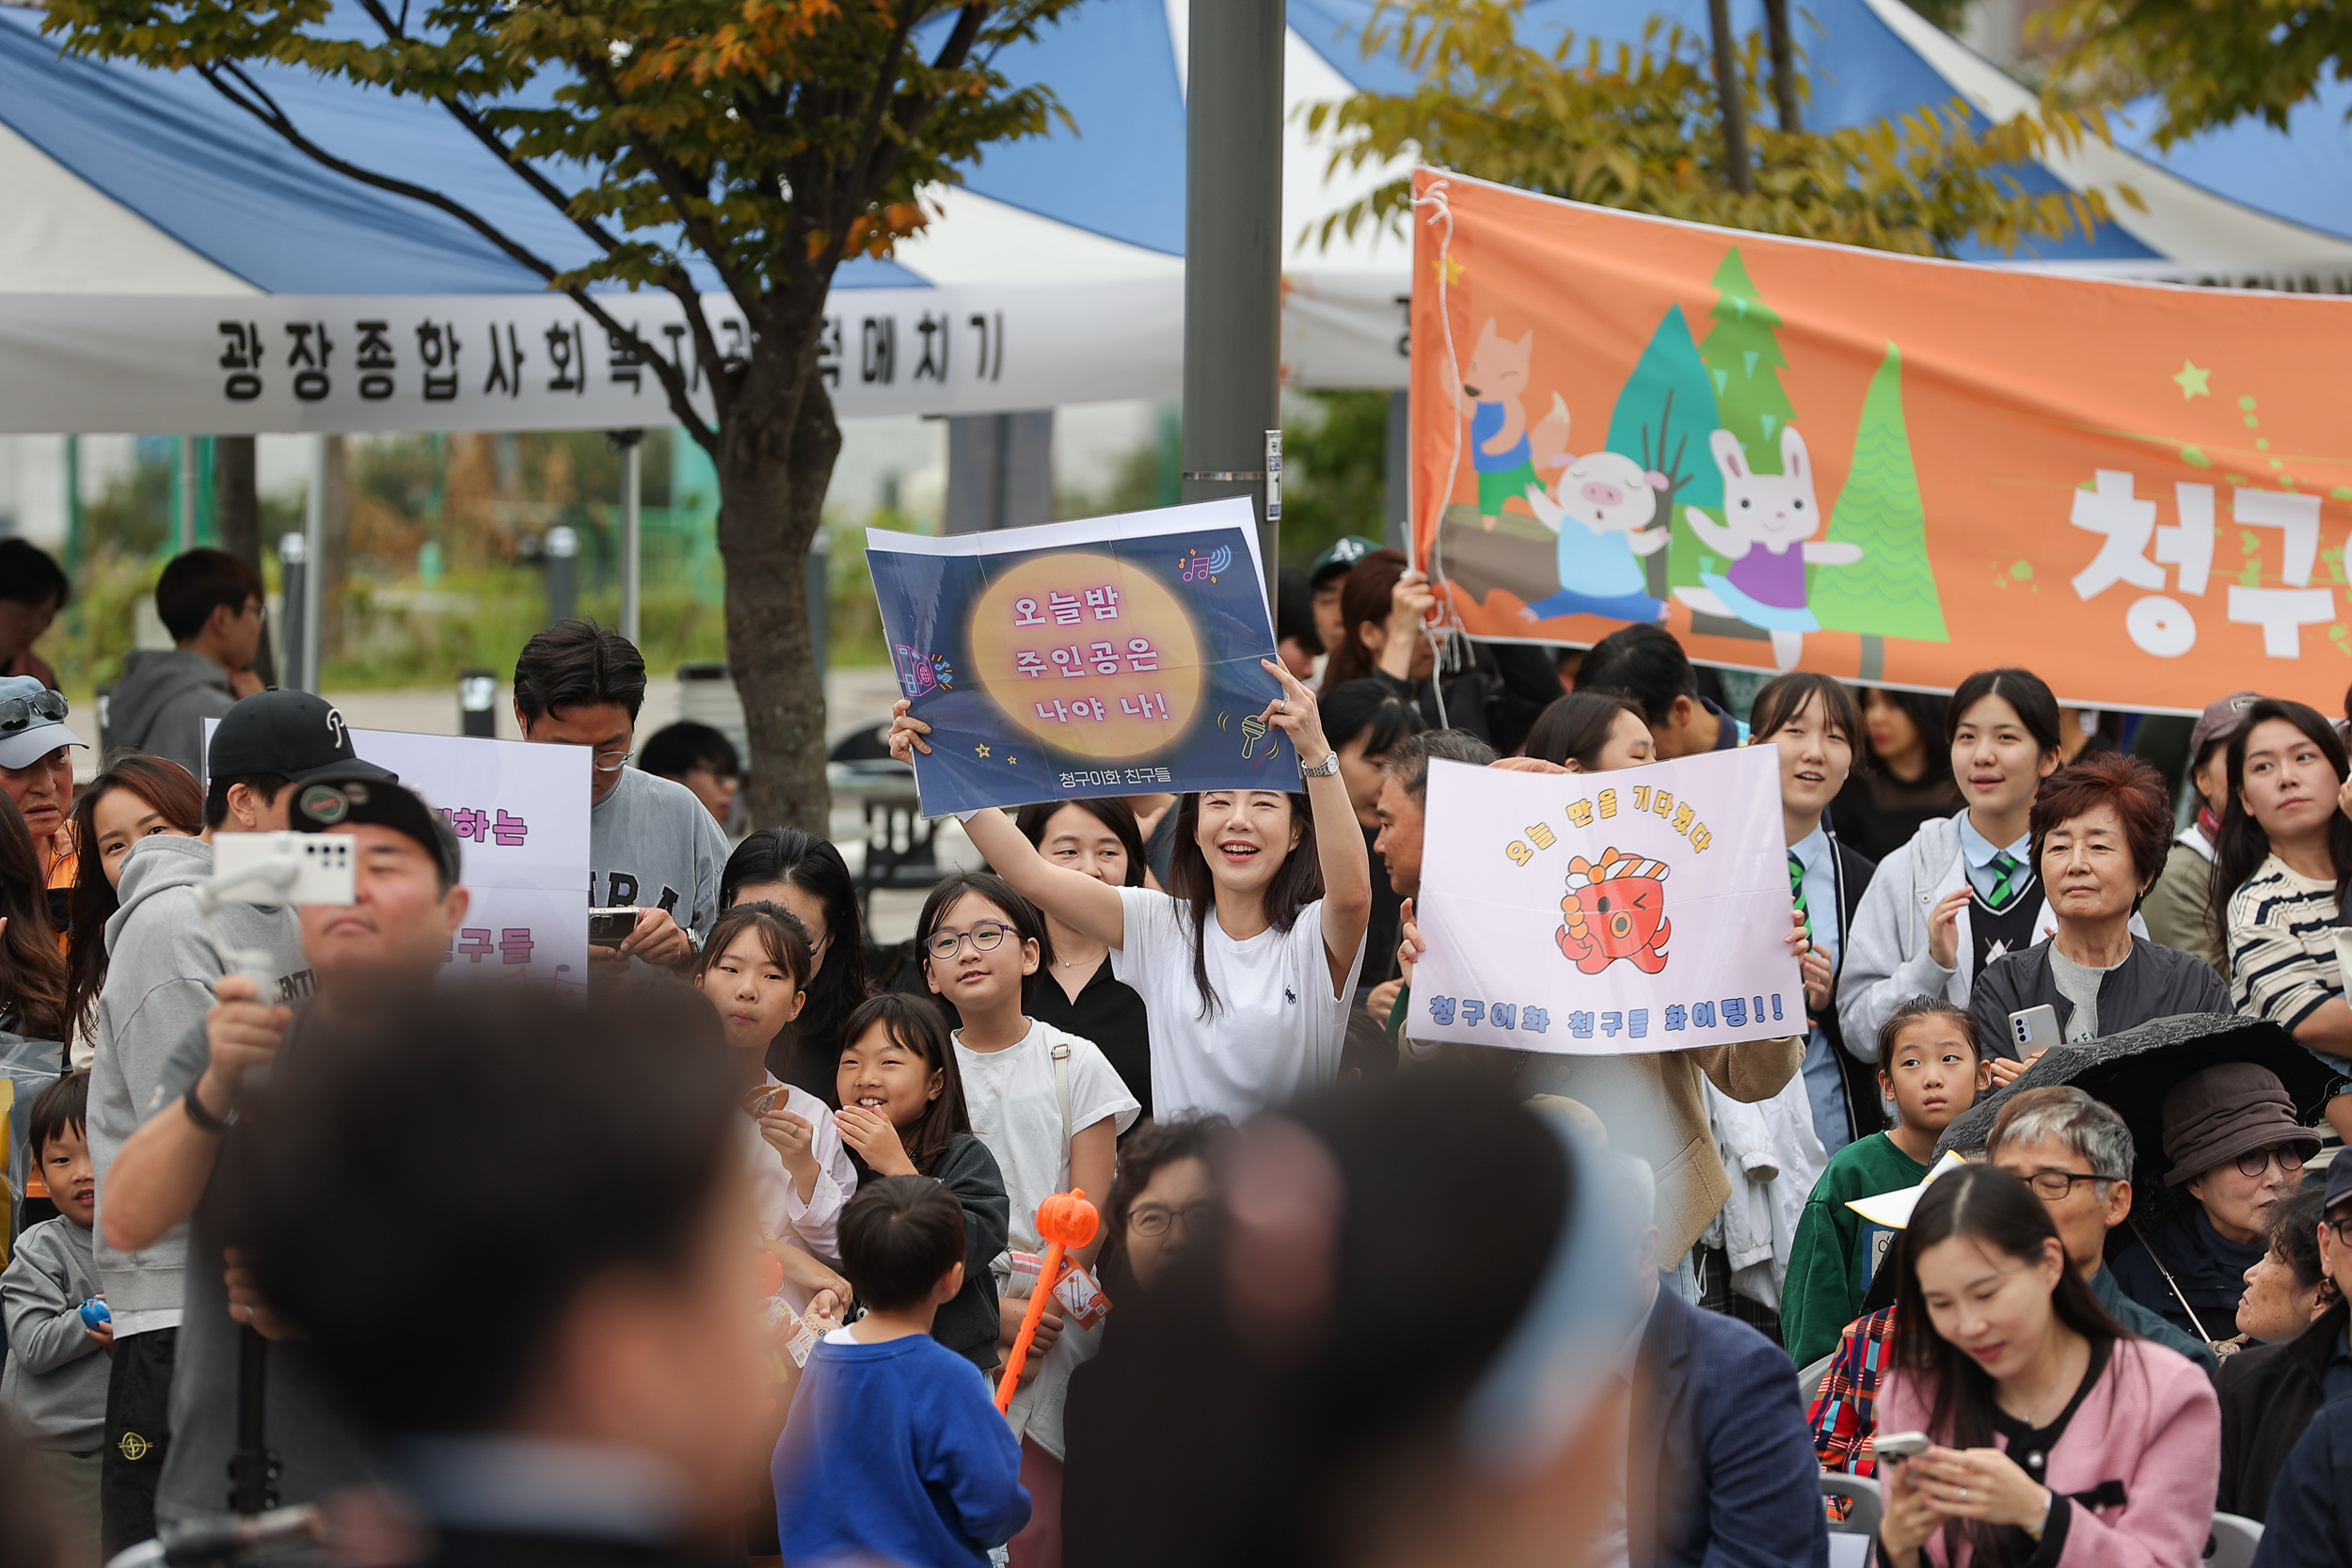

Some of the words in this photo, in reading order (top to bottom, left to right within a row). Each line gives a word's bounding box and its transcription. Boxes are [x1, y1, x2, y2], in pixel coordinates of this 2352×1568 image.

[2070, 468, 2352, 660] 청구
[1014, 585, 1120, 626] 오늘밤
[1015, 638, 1158, 678] 주인공은
[1035, 697, 1105, 723] 나야
[1120, 692, 1169, 721] 나!
[1058, 769, 1120, 788] 청구이화
[1123, 767, 1172, 784] 친구들
[436, 807, 528, 847] 하는
[1506, 821, 1557, 866] 오늘
[1565, 788, 1617, 828] 만을
[1632, 785, 1712, 854] 기다렸다
[444, 927, 534, 965] 구들
[1428, 994, 1549, 1035] 청구이화
[1568, 1009, 1649, 1038] 친구들
[1664, 993, 1784, 1031] 화이팅!!
